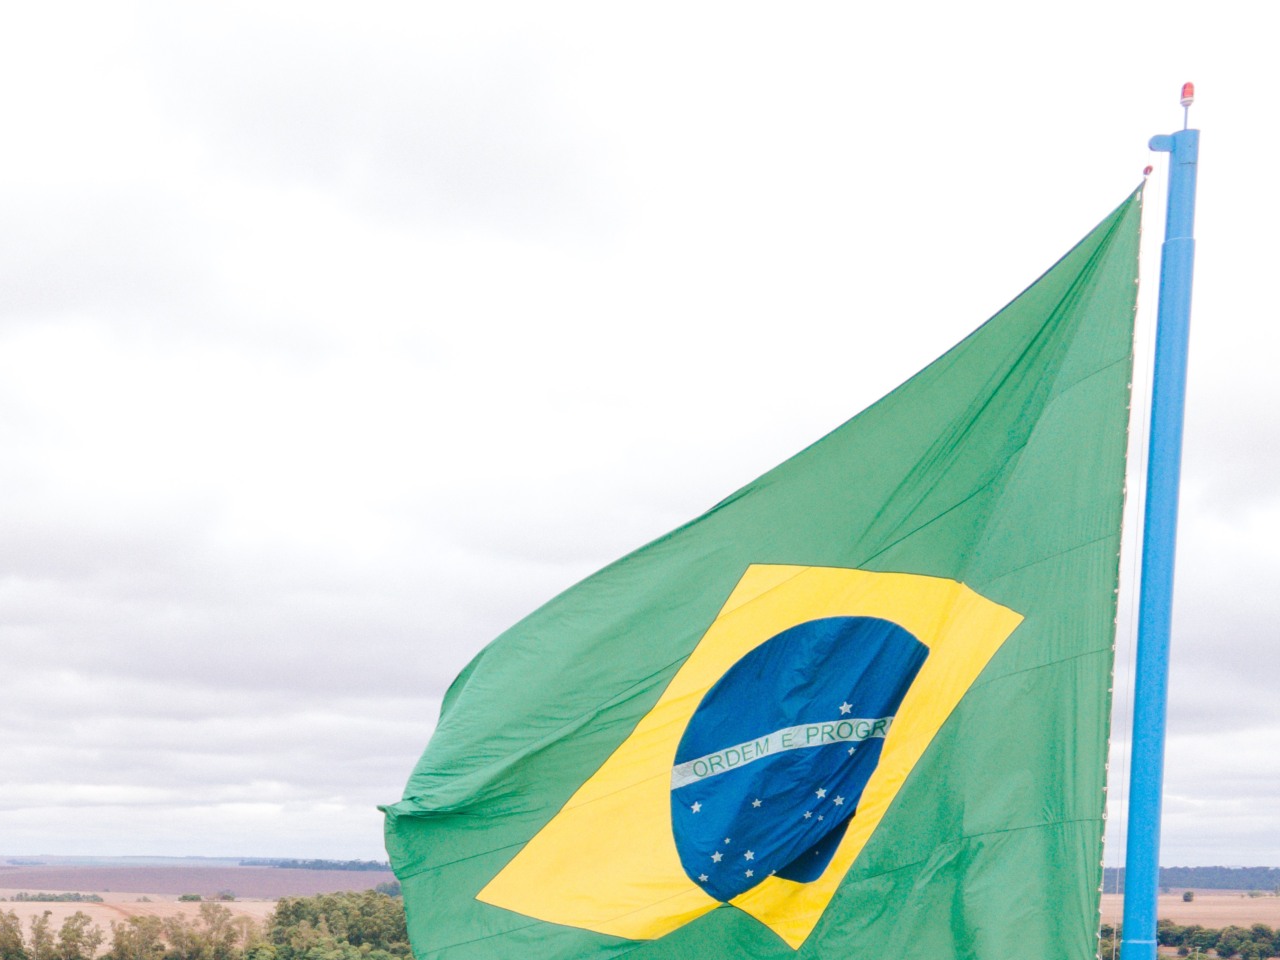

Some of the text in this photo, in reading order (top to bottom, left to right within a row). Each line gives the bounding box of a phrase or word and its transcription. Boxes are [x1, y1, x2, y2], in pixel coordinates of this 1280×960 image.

[693, 719, 893, 777] ORDEM E PROGR
